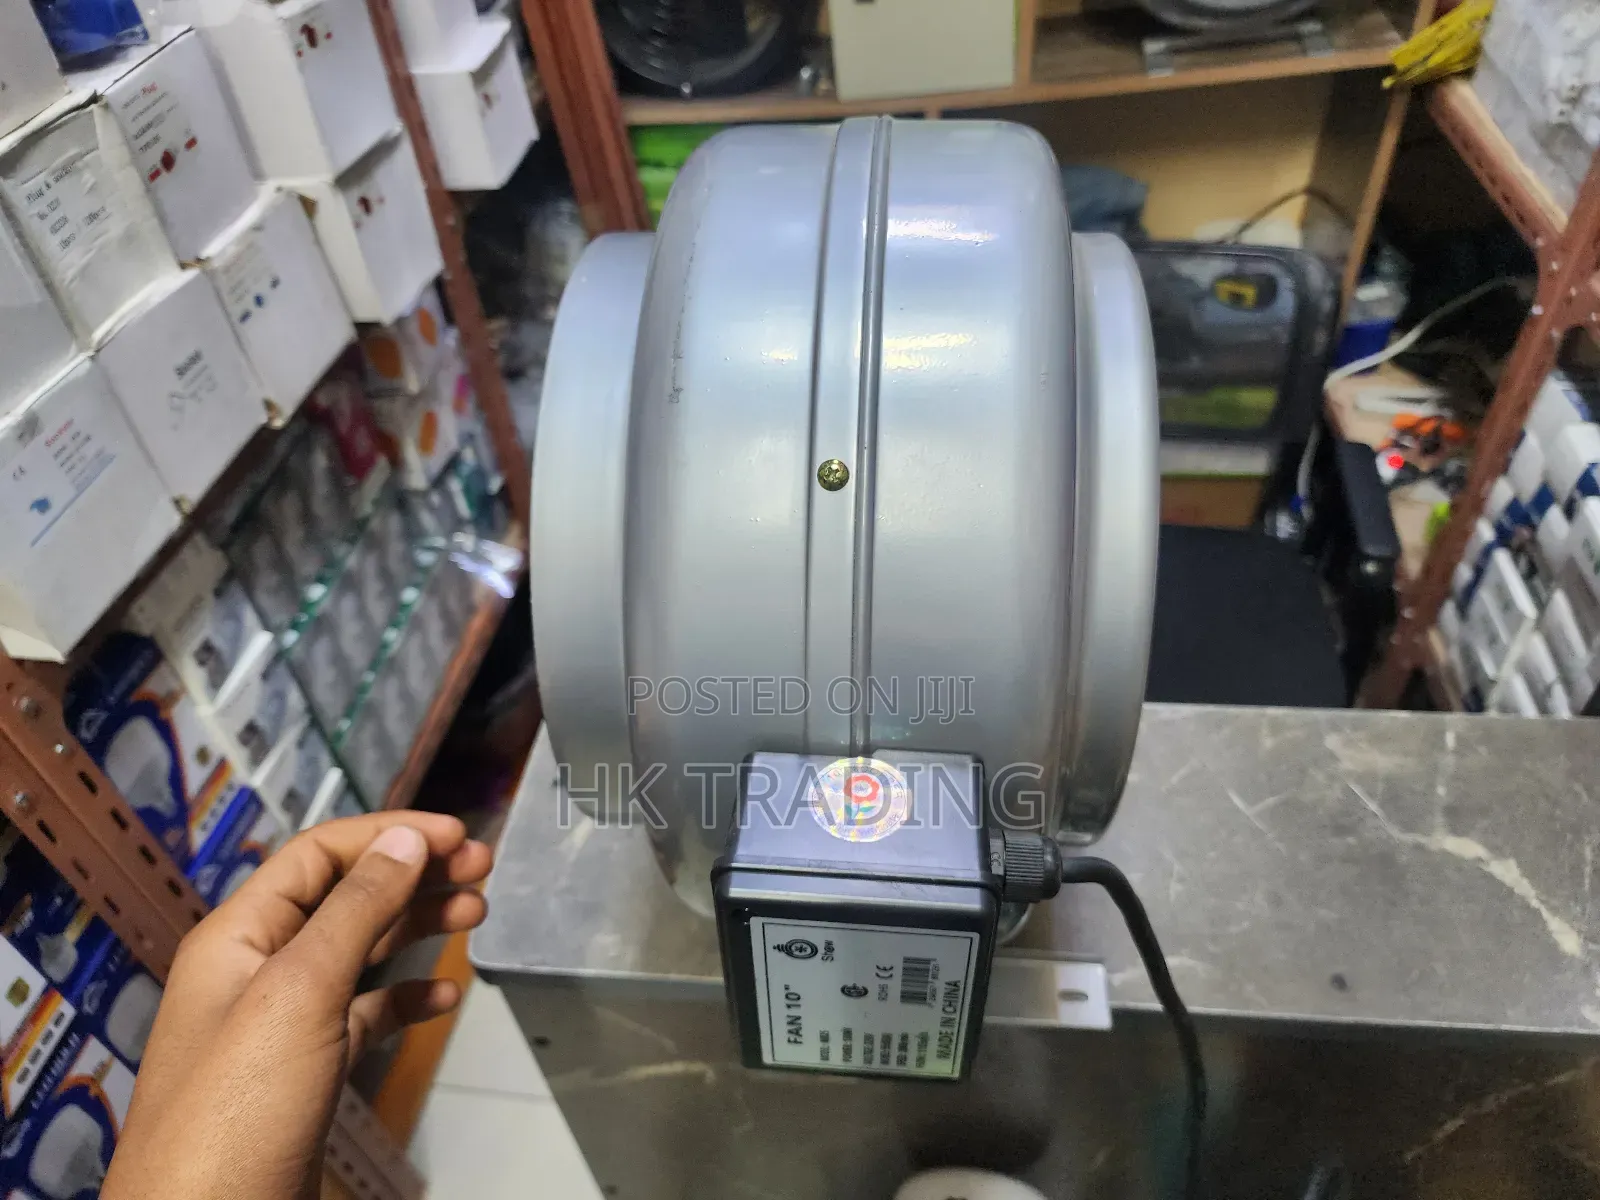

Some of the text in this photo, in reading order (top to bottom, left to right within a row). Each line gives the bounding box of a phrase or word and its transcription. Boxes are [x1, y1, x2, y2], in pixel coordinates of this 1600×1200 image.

[875, 964, 894, 979] CE
[783, 984, 803, 1045] FAN 10"
[936, 979, 961, 1060] MADE IN CHINA
